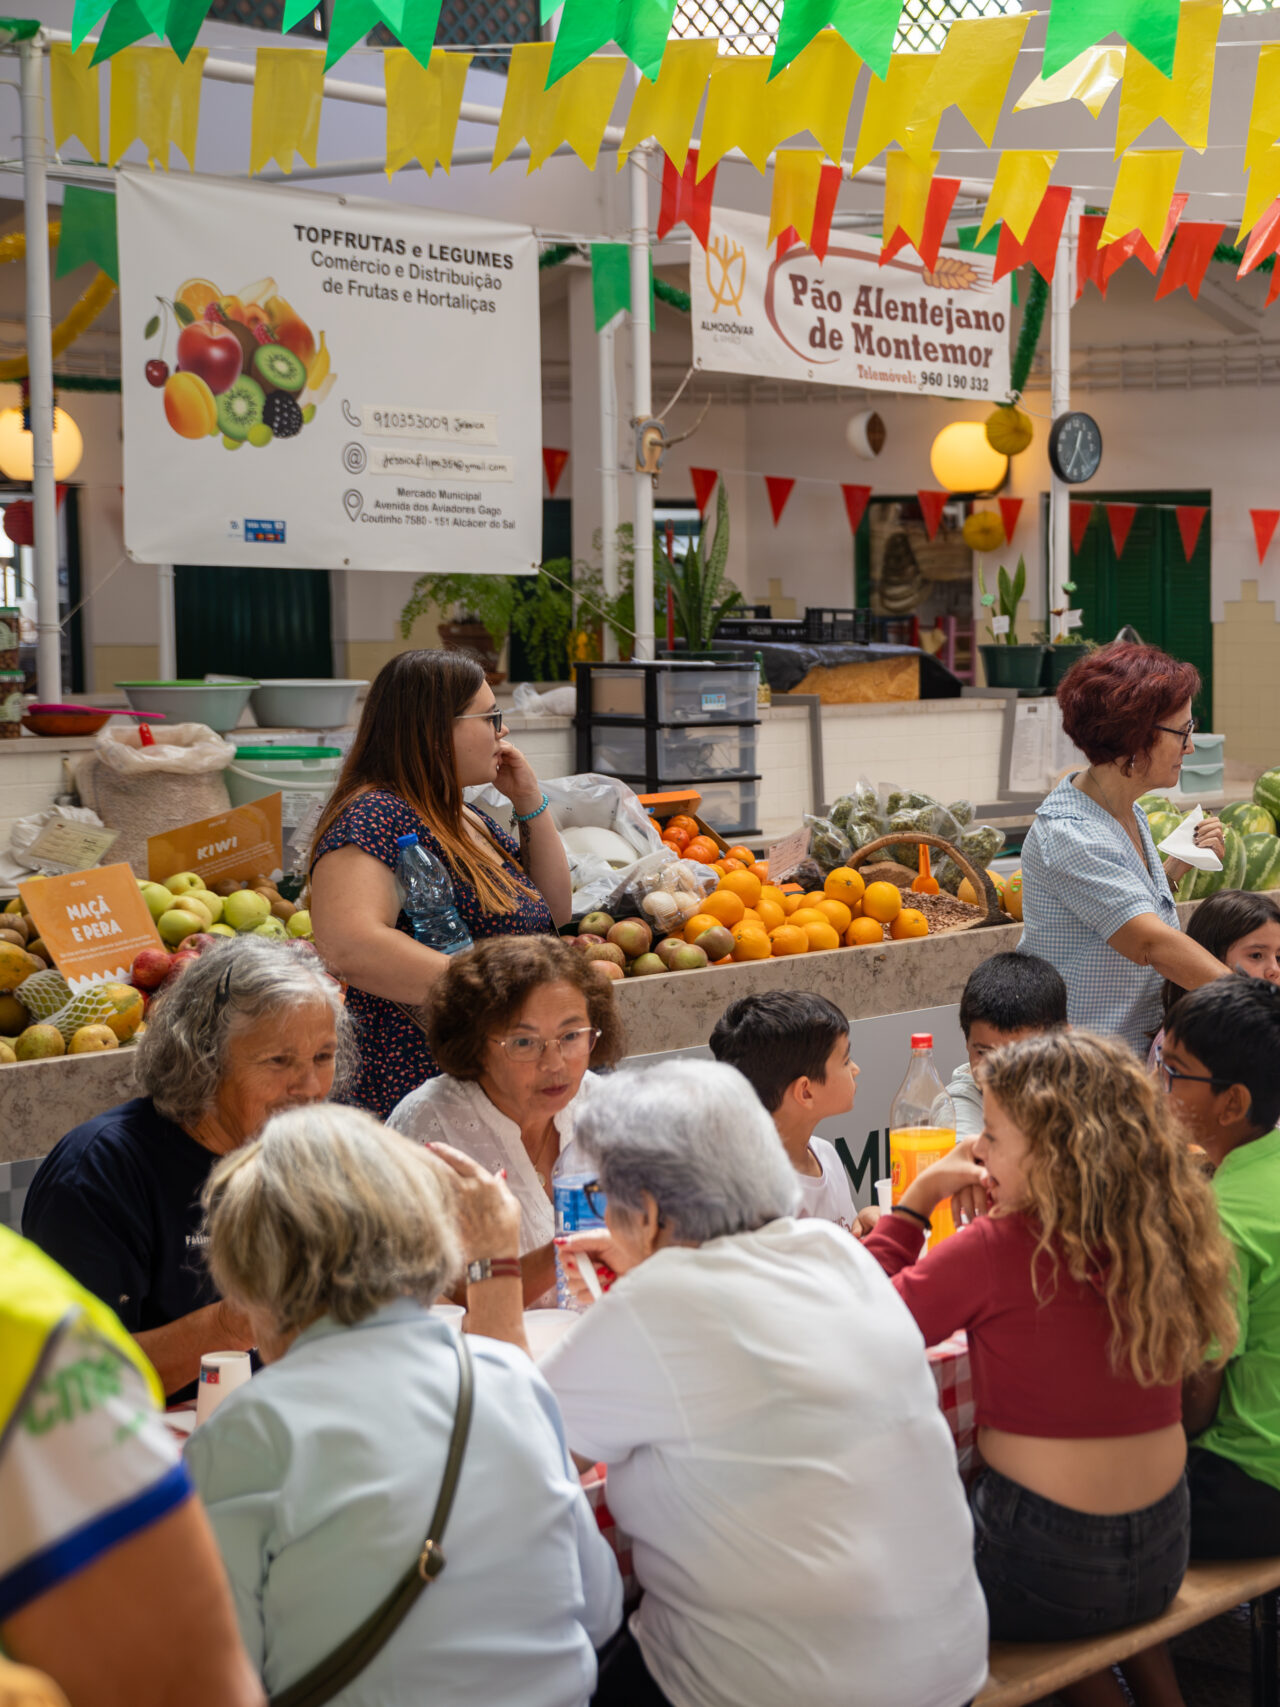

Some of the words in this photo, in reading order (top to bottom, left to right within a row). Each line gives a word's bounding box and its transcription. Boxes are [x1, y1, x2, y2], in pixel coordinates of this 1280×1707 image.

[293, 224, 406, 255] TOPFRUTAS
[412, 244, 423, 258] e
[428, 243, 514, 270] LEGUMES
[311, 250, 391, 276] Comércio
[395, 265, 405, 277] e
[409, 263, 502, 290] Distribuição
[322, 277, 343, 295] de
[348, 279, 399, 302] Frutas
[403, 289, 413, 303] e
[417, 287, 497, 314] Hortaliças
[788, 273, 843, 313] Pão
[853, 284, 1006, 336] Alentejano
[808, 316, 844, 351] de
[851, 321, 993, 369] Montemor
[856, 364, 917, 386] Telemóvel:
[920, 370, 942, 388] 960
[947, 371, 968, 390] 190
[970, 373, 990, 393] 332
[397, 487, 437, 499] Mercado
[439, 489, 482, 502] Municipal
[361, 512, 403, 525] Coutinho
[405, 515, 426, 526] 7580
[434, 516, 450, 527] 151
[453, 514, 487, 528] Alcácer
[490, 518, 500, 529] do
[503, 519, 516, 530] Sal
[374, 500, 411, 512] Avenida
[413, 501, 429, 513] dos
[431, 502, 476, 515] Aviadores
[478, 505, 502, 518] Gago
[197, 836, 238, 861] KIWI
[66, 895, 112, 921] MAÇÃ
[71, 926, 84, 943] E
[82, 919, 123, 940] PERA
